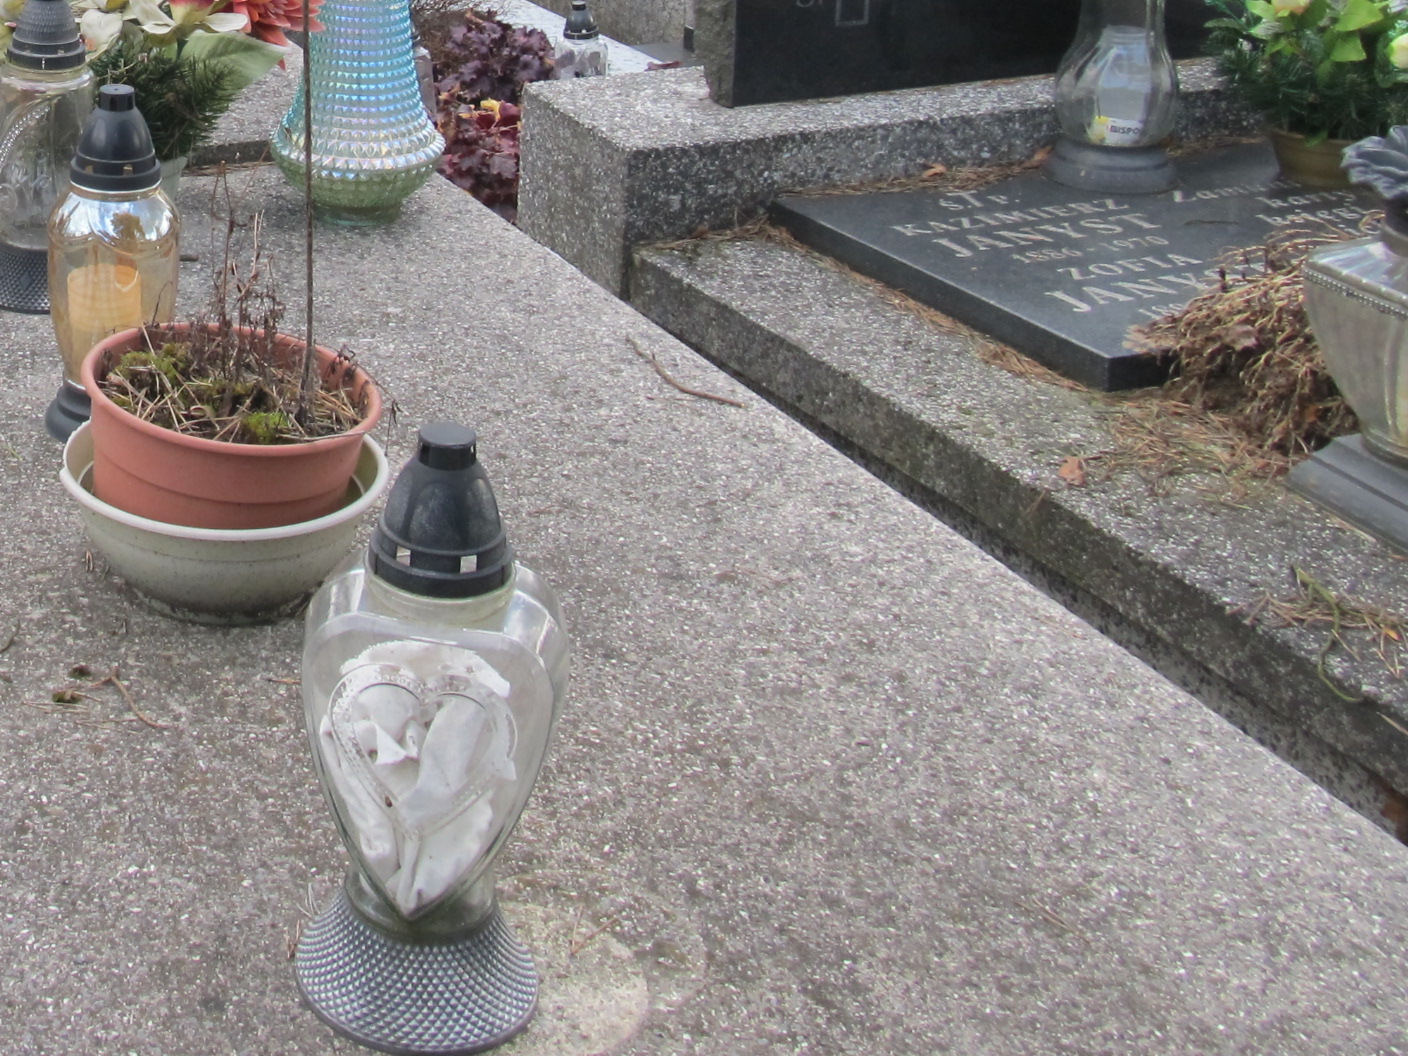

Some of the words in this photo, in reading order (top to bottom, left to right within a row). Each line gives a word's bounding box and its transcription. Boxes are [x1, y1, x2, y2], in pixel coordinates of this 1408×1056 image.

[891, 198, 1130, 237] KAZIMIERZ
[930, 212, 1163, 259] JANYST
[1100, 234, 1170, 252] 1970
[1056, 253, 1204, 281] ZOFIA
